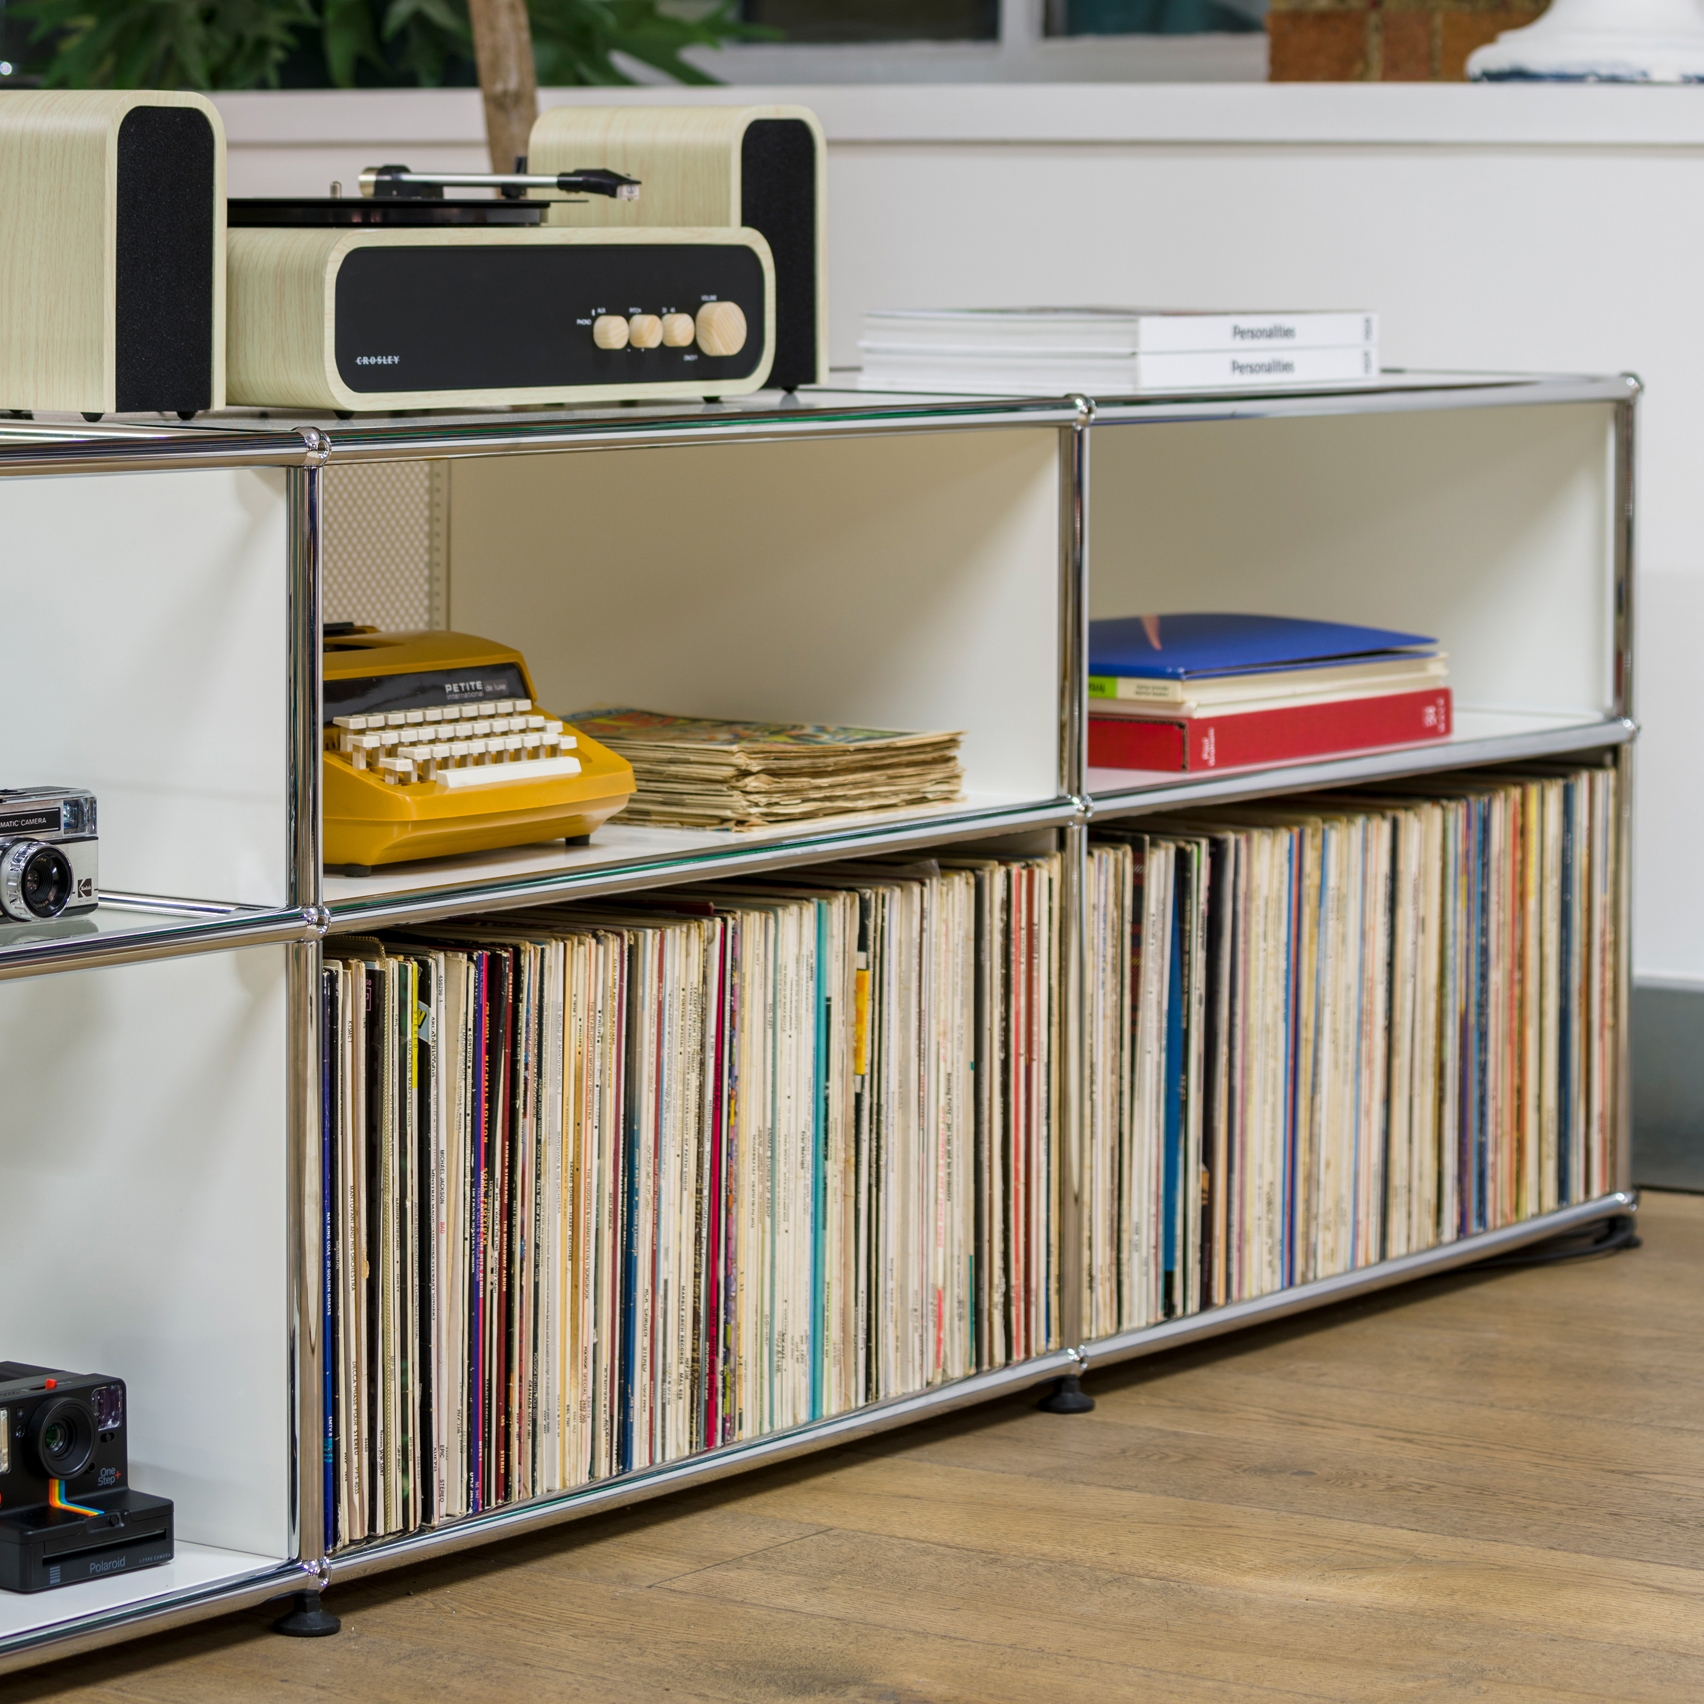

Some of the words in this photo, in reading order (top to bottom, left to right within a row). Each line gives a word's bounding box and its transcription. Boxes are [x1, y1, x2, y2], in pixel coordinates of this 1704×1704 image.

[1232, 325, 1296, 340] Personalities
[355, 355, 400, 365] CROSLEY
[1231, 360, 1294, 375] Personalities
[445, 681, 483, 693] PETITE
[447, 691, 484, 700] international
[21, 818, 47, 826] CAMERA
[536, 1195, 541, 1206] ME
[536, 1206, 541, 1215] ON
[327, 1260, 331, 1269] 20
[101, 1467, 115, 1477] One
[98, 1476, 115, 1486] Step
[90, 1556, 126, 1574] Polaroid
